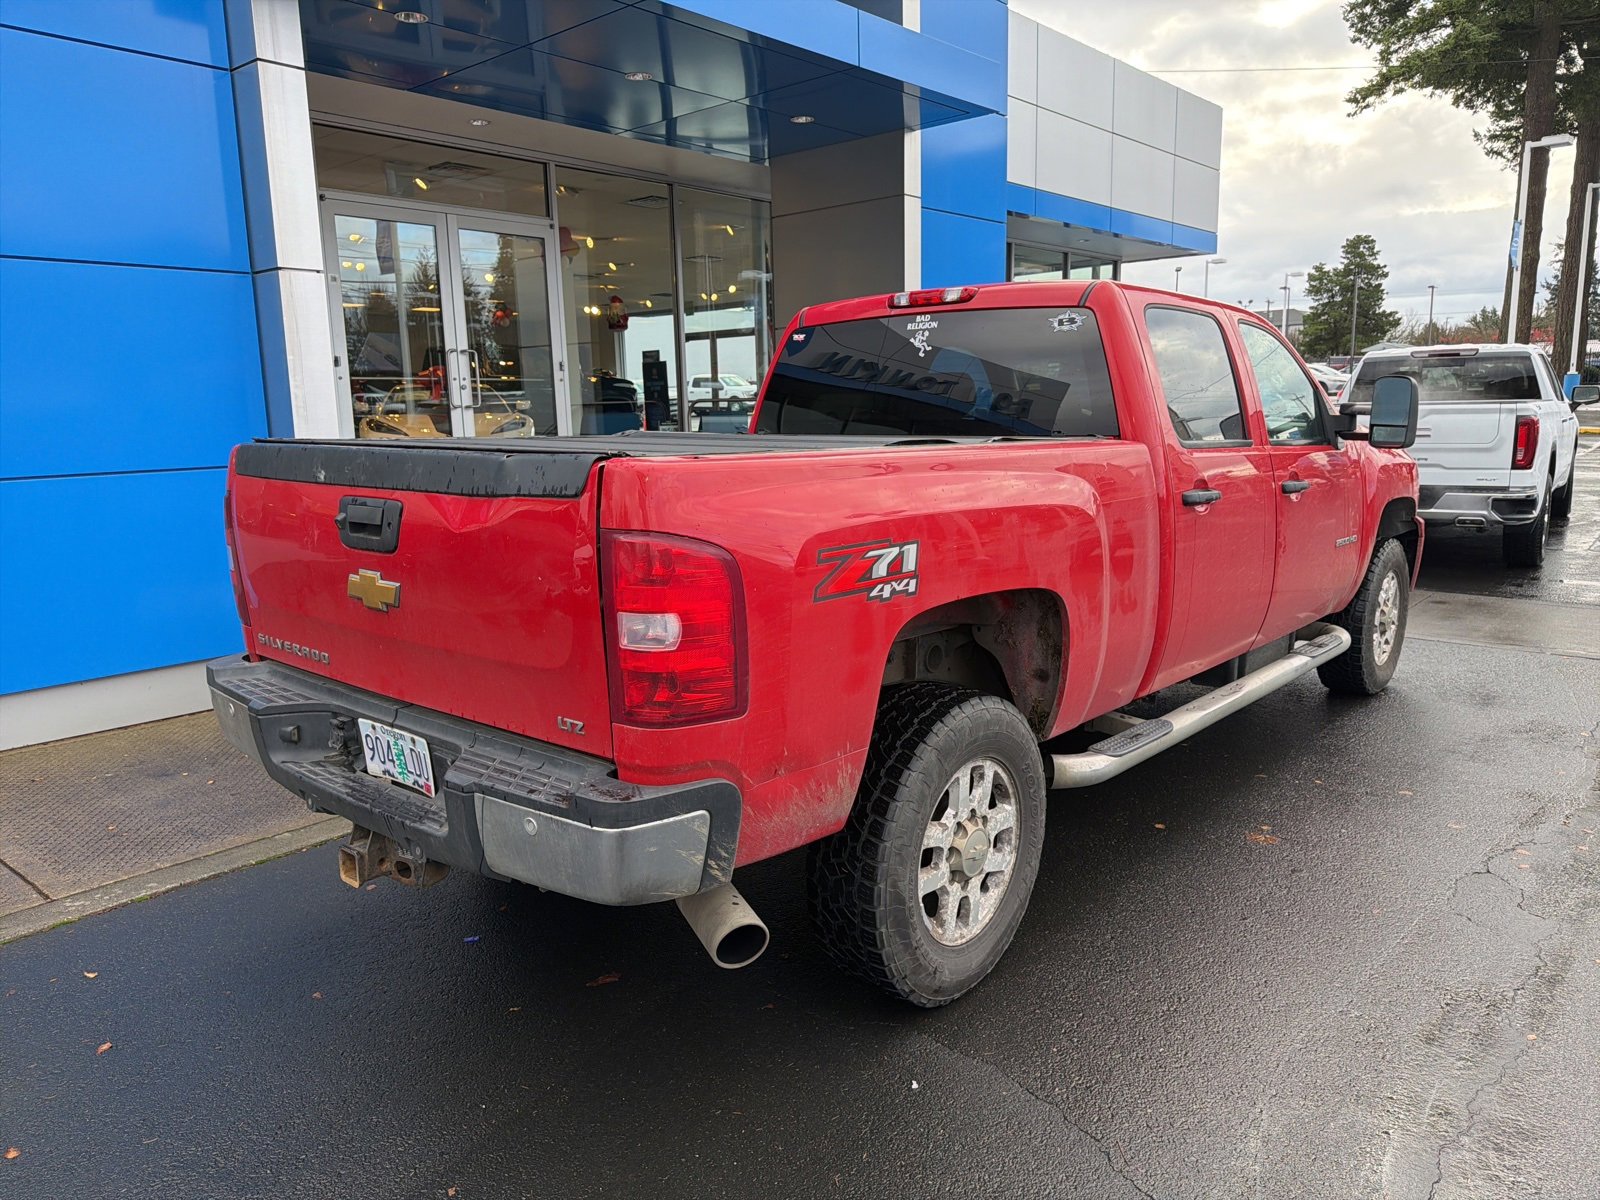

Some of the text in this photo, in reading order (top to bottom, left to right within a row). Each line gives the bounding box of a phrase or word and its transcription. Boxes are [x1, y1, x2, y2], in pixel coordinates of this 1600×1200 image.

[906, 321, 939, 331] RELIGION
[915, 314, 931, 322] BAD
[814, 539, 920, 603] Z71
[258, 633, 330, 665] SILVERADO
[380, 725, 407, 743] Oregon
[557, 716, 585, 735] LTZ
[364, 733, 430, 782] 904 LDU
[1022, 761, 1041, 817] TOYO
